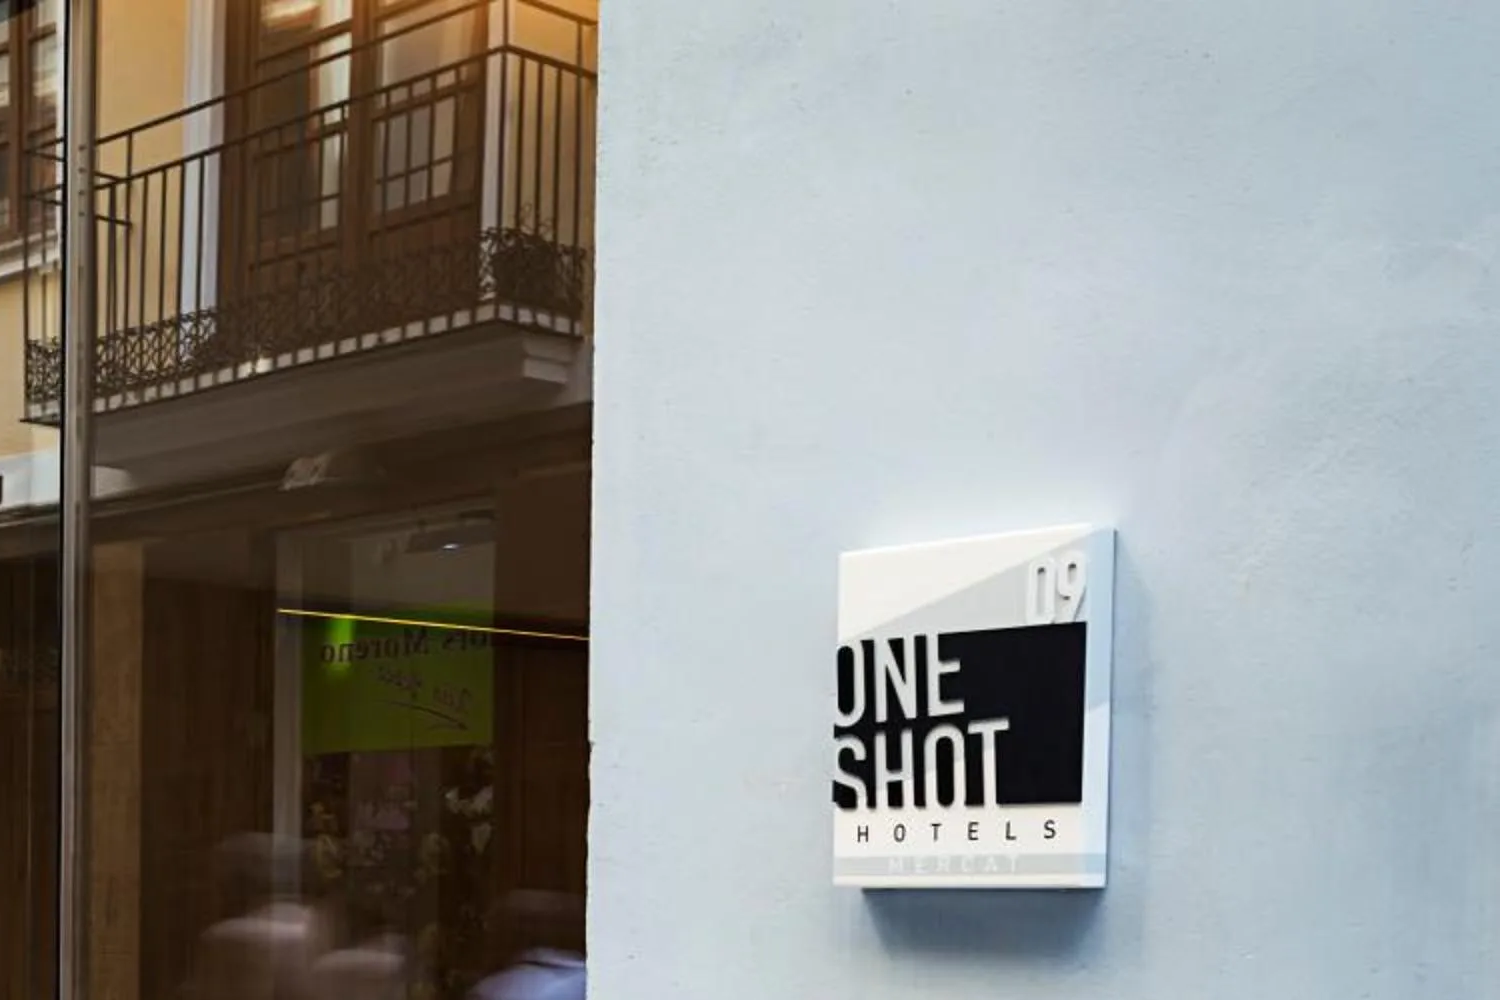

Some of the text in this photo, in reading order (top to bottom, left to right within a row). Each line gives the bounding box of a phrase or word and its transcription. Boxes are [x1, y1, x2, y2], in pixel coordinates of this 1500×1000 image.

[1026, 550, 1088, 623] 09
[833, 624, 965, 727] ONE
[832, 717, 1010, 811] SHOT
[856, 819, 1057, 843] HOTELS
[887, 853, 1021, 874] MERCAT
